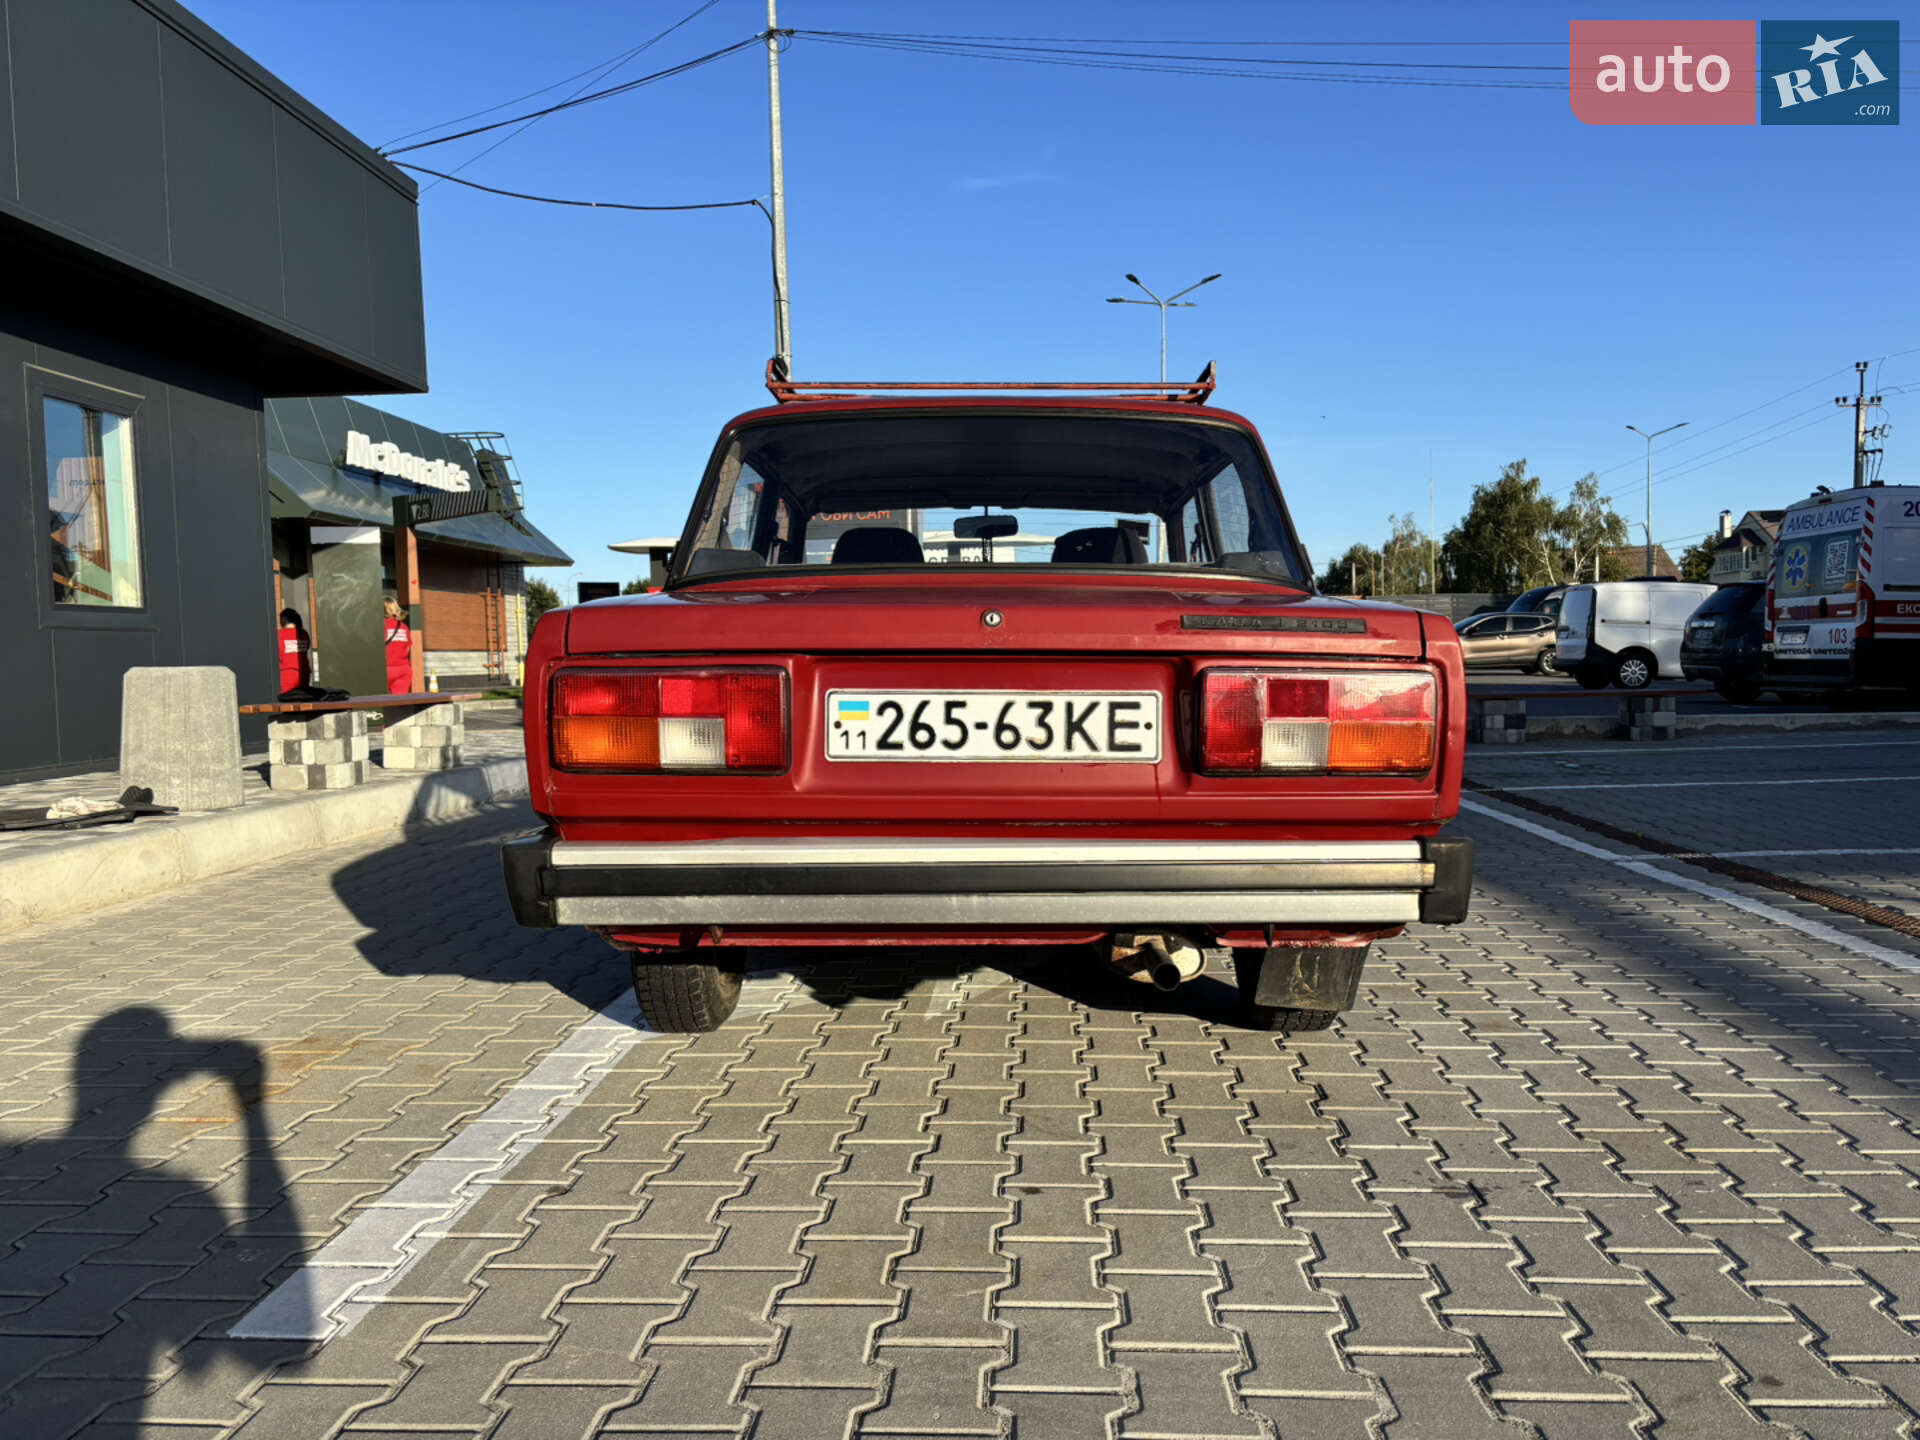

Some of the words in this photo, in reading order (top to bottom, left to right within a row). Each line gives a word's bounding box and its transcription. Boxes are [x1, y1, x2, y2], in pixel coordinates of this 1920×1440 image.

[1786, 505, 1861, 534] AMBULANCE
[1827, 628, 1848, 645] 103
[875, 700, 1142, 751] 265-63KE
[839, 730, 866, 750] 11
